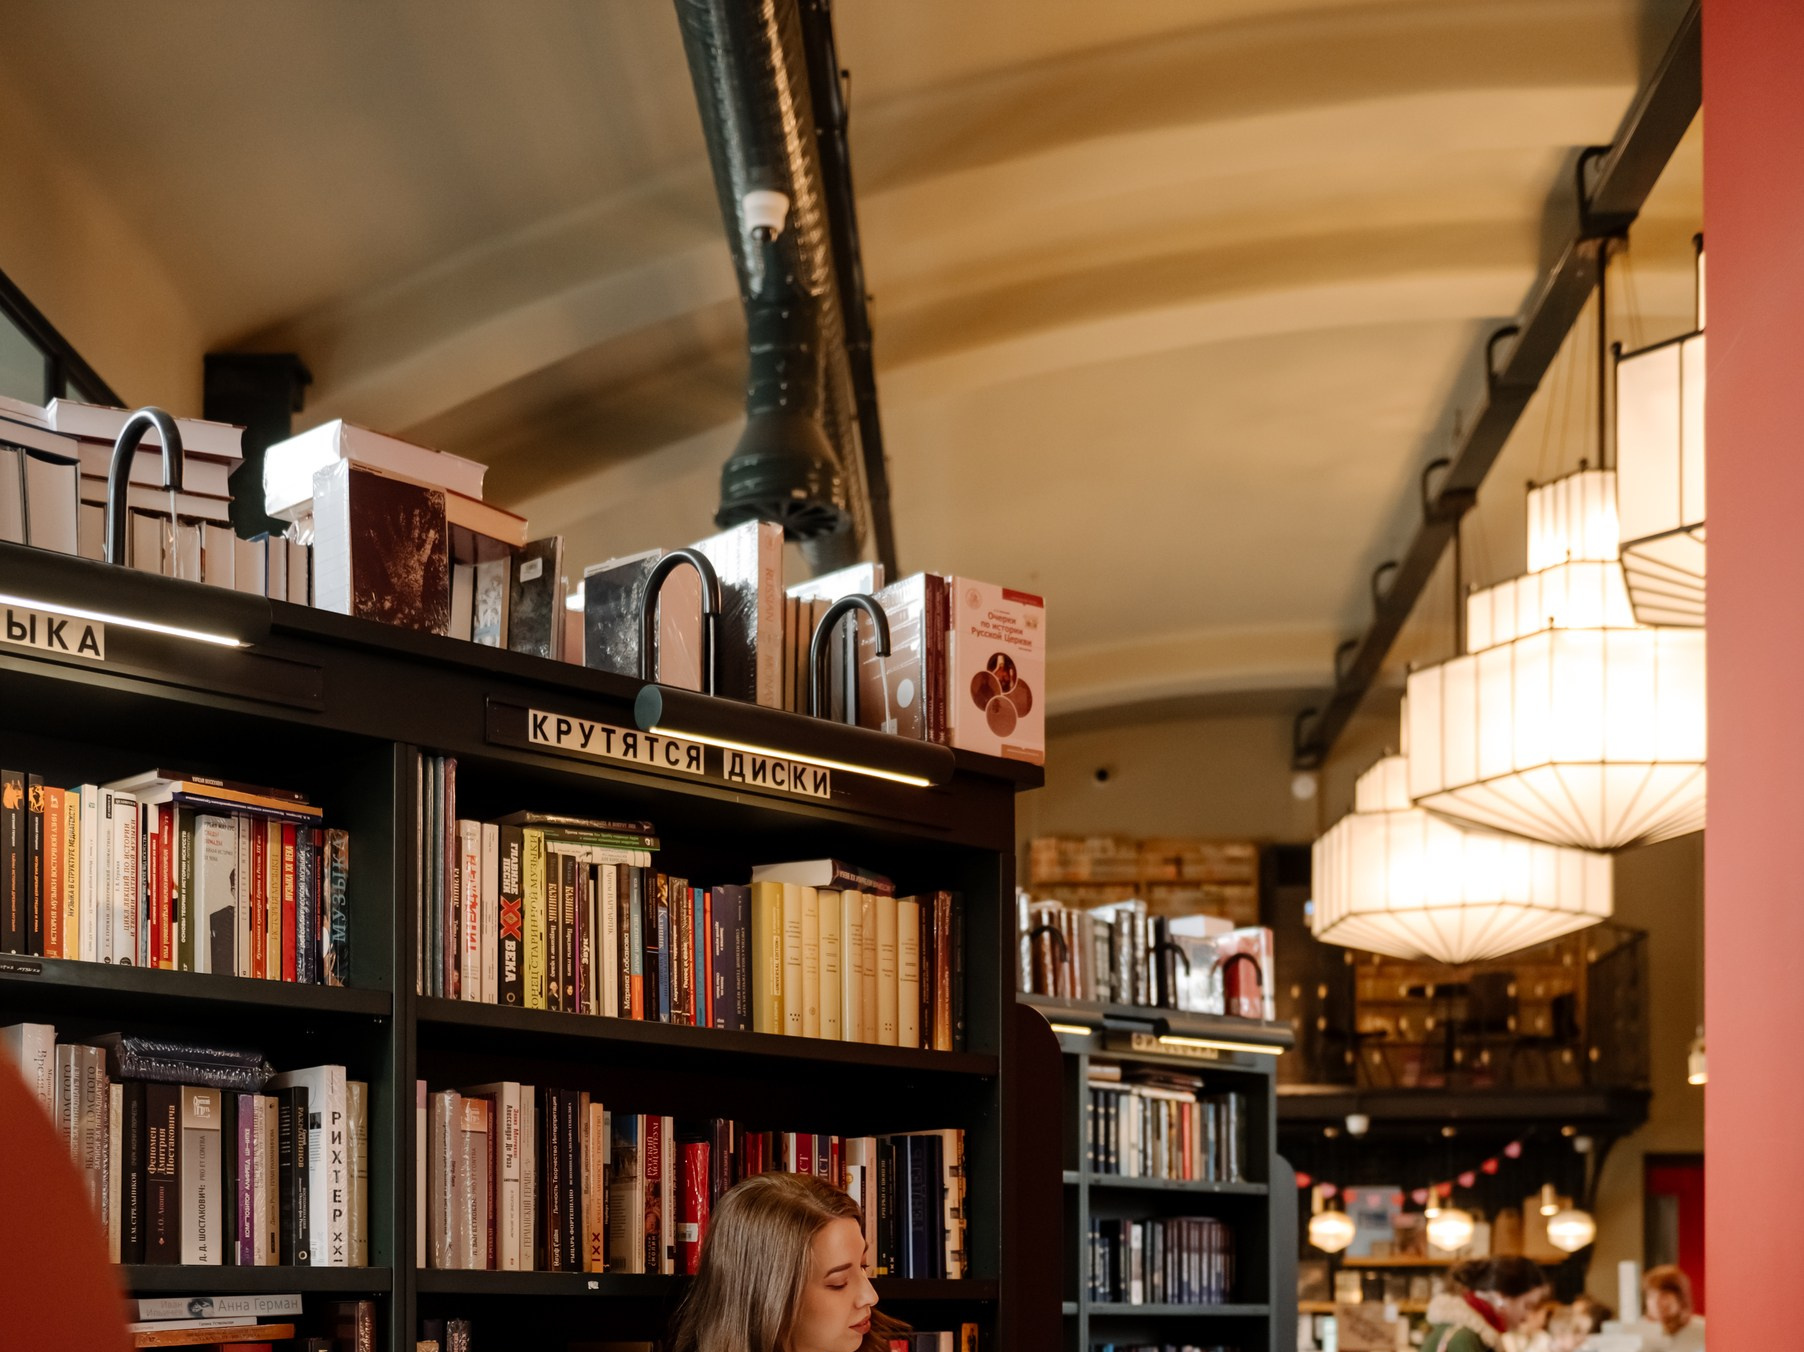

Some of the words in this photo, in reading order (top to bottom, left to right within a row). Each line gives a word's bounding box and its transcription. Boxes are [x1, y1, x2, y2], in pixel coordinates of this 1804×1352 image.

[971, 626, 1002, 640] Русской
[1004, 634, 1032, 646] Церкви
[988, 611, 1016, 624] Очерки
[992, 623, 1023, 635] истории
[531, 711, 702, 771] КРУТЯТСЯ
[729, 752, 828, 796] ДИСКИ
[50, 834, 58, 878] ВОСТОЧНОЙ
[123, 862, 130, 873] ПО
[285, 845, 294, 862] ВЕКА
[509, 842, 519, 895] ГЛАВНЫЕ
[50, 878, 58, 910] МУЗЫКИ
[285, 873, 294, 902] МУЗЫКА
[332, 838, 346, 943] МУЗЫКА
[502, 857, 511, 893] ПЕСНИ
[565, 886, 573, 925] КАЗИНИК
[50, 911, 58, 945] ИСТОРИЯ
[504, 940, 517, 983] ВЕКА
[622, 933, 630, 974] Лобанова
[623, 975, 631, 1009] Марина
[63, 1064, 72, 1124] ТОЛСТОГО
[86, 1066, 95, 1125] ТОЛСТОГО
[85, 1128, 94, 1169] ВБЛИЗИ
[148, 1127, 157, 1175] Феномен
[157, 1128, 166, 1175] Дмитрия
[166, 1105, 176, 1175] Шостаковича
[505, 1143, 512, 1151] Де
[331, 1111, 343, 1222] РИХТЕР
[523, 1170, 531, 1198] ГЕРМЕС
[198, 1184, 206, 1242] ШОСТАКОВИЧ:
[523, 1200, 531, 1247] ГЕРМАНСКИЙ
[199, 1243, 207, 1252] Д.
[218, 1300, 250, 1312] Анна
[254, 1297, 298, 1310] Герман
